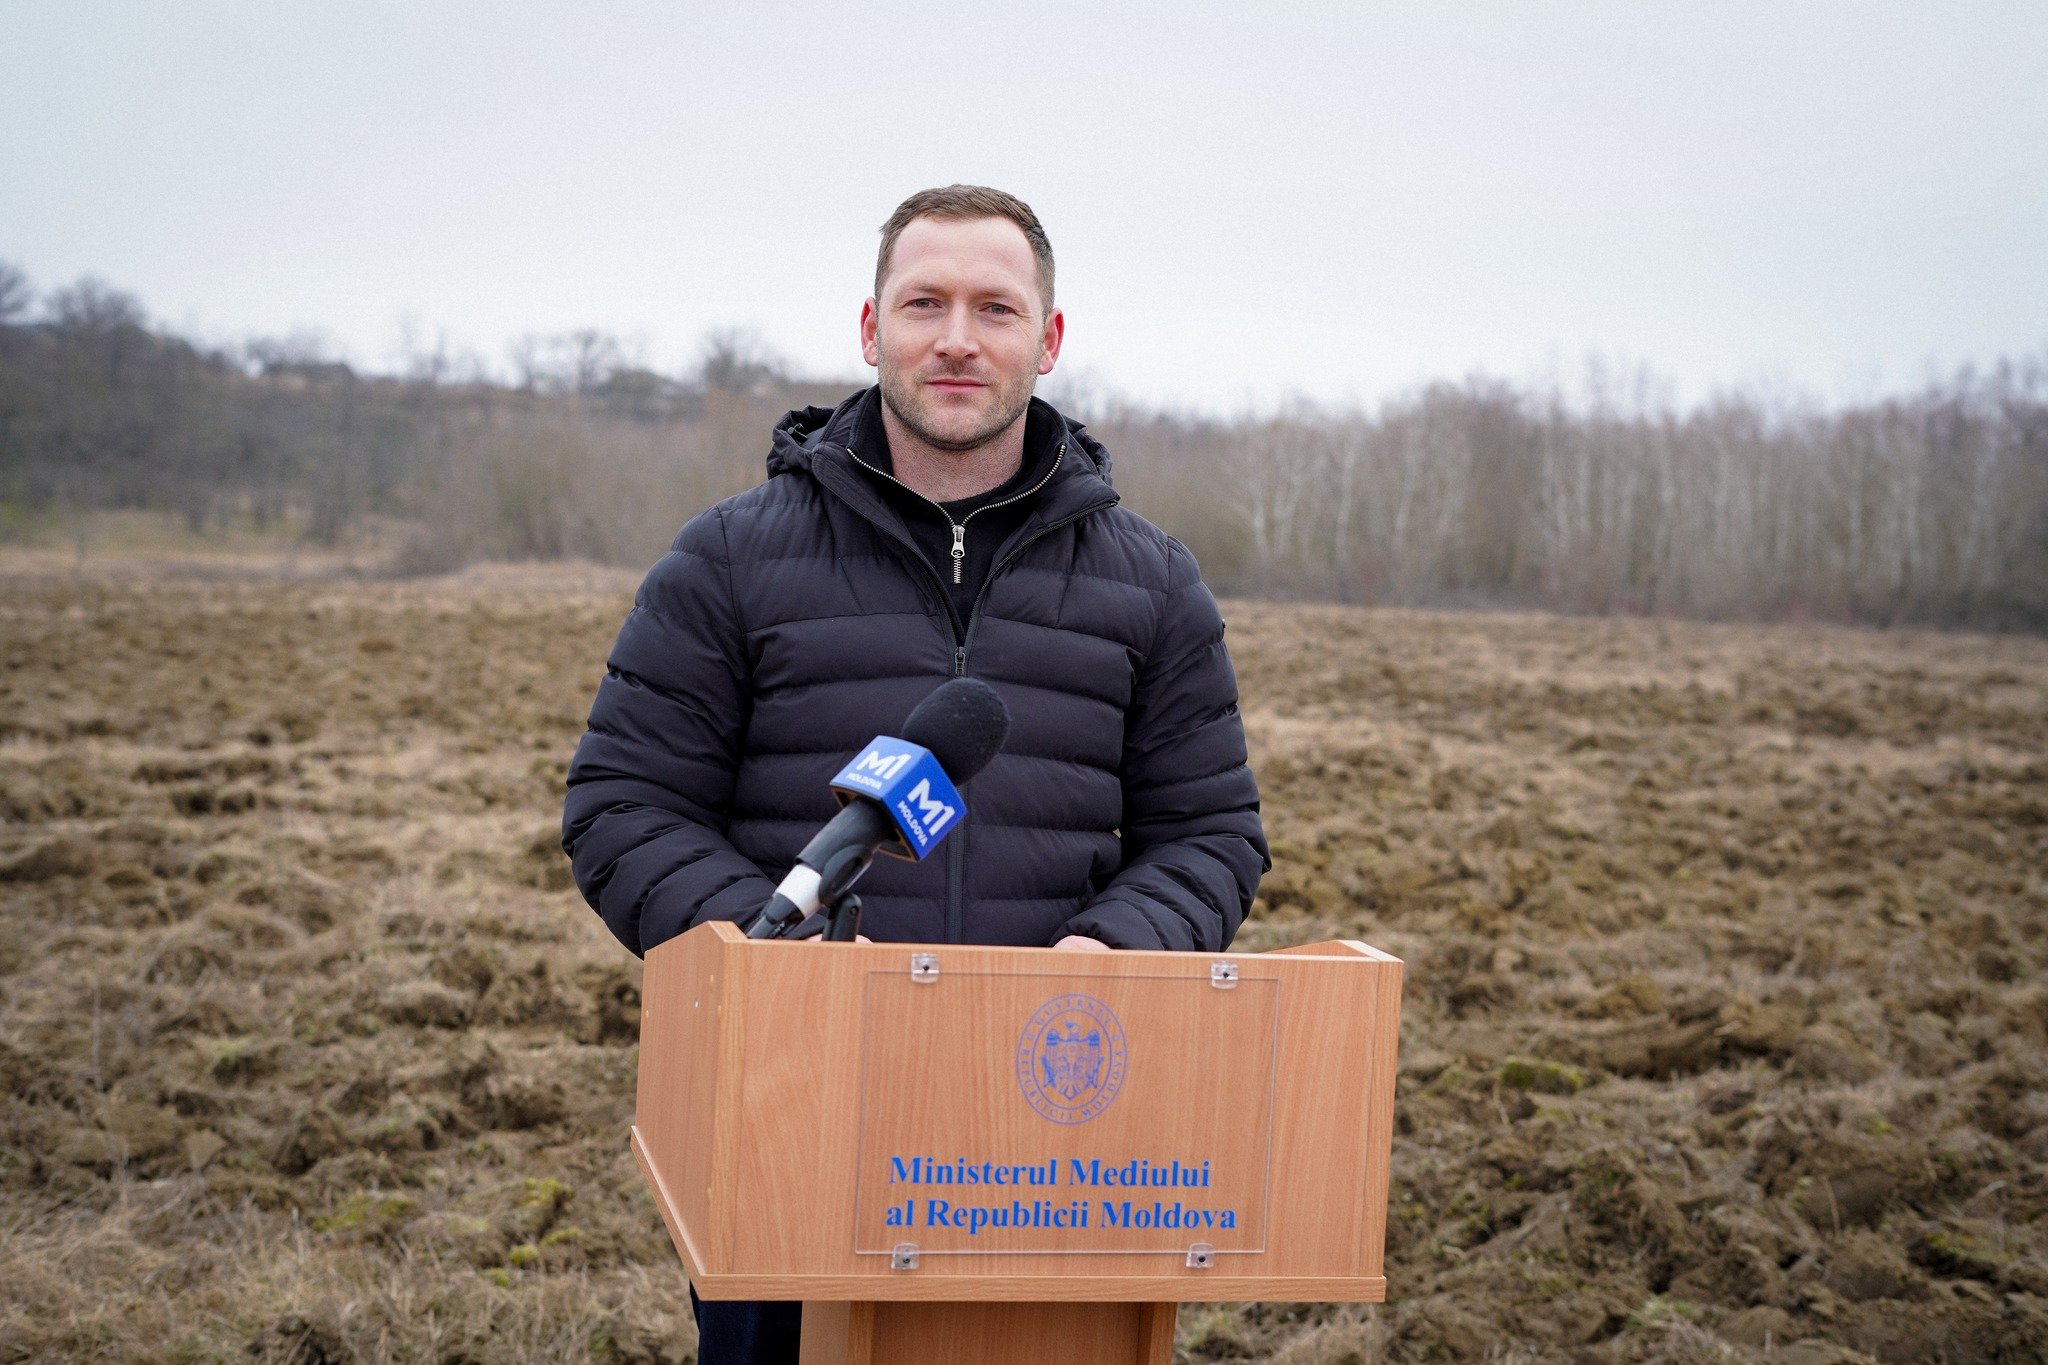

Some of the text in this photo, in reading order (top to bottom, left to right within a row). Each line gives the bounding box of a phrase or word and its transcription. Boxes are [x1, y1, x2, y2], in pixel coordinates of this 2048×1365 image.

[845, 772, 882, 790] MOLDOVA
[856, 750, 912, 780] M1
[897, 800, 928, 848] MOLDOVA
[907, 777, 956, 837] M1
[889, 1156, 1211, 1188] Ministerul Mediului
[886, 1199, 1237, 1236] al Republicii Moldova
